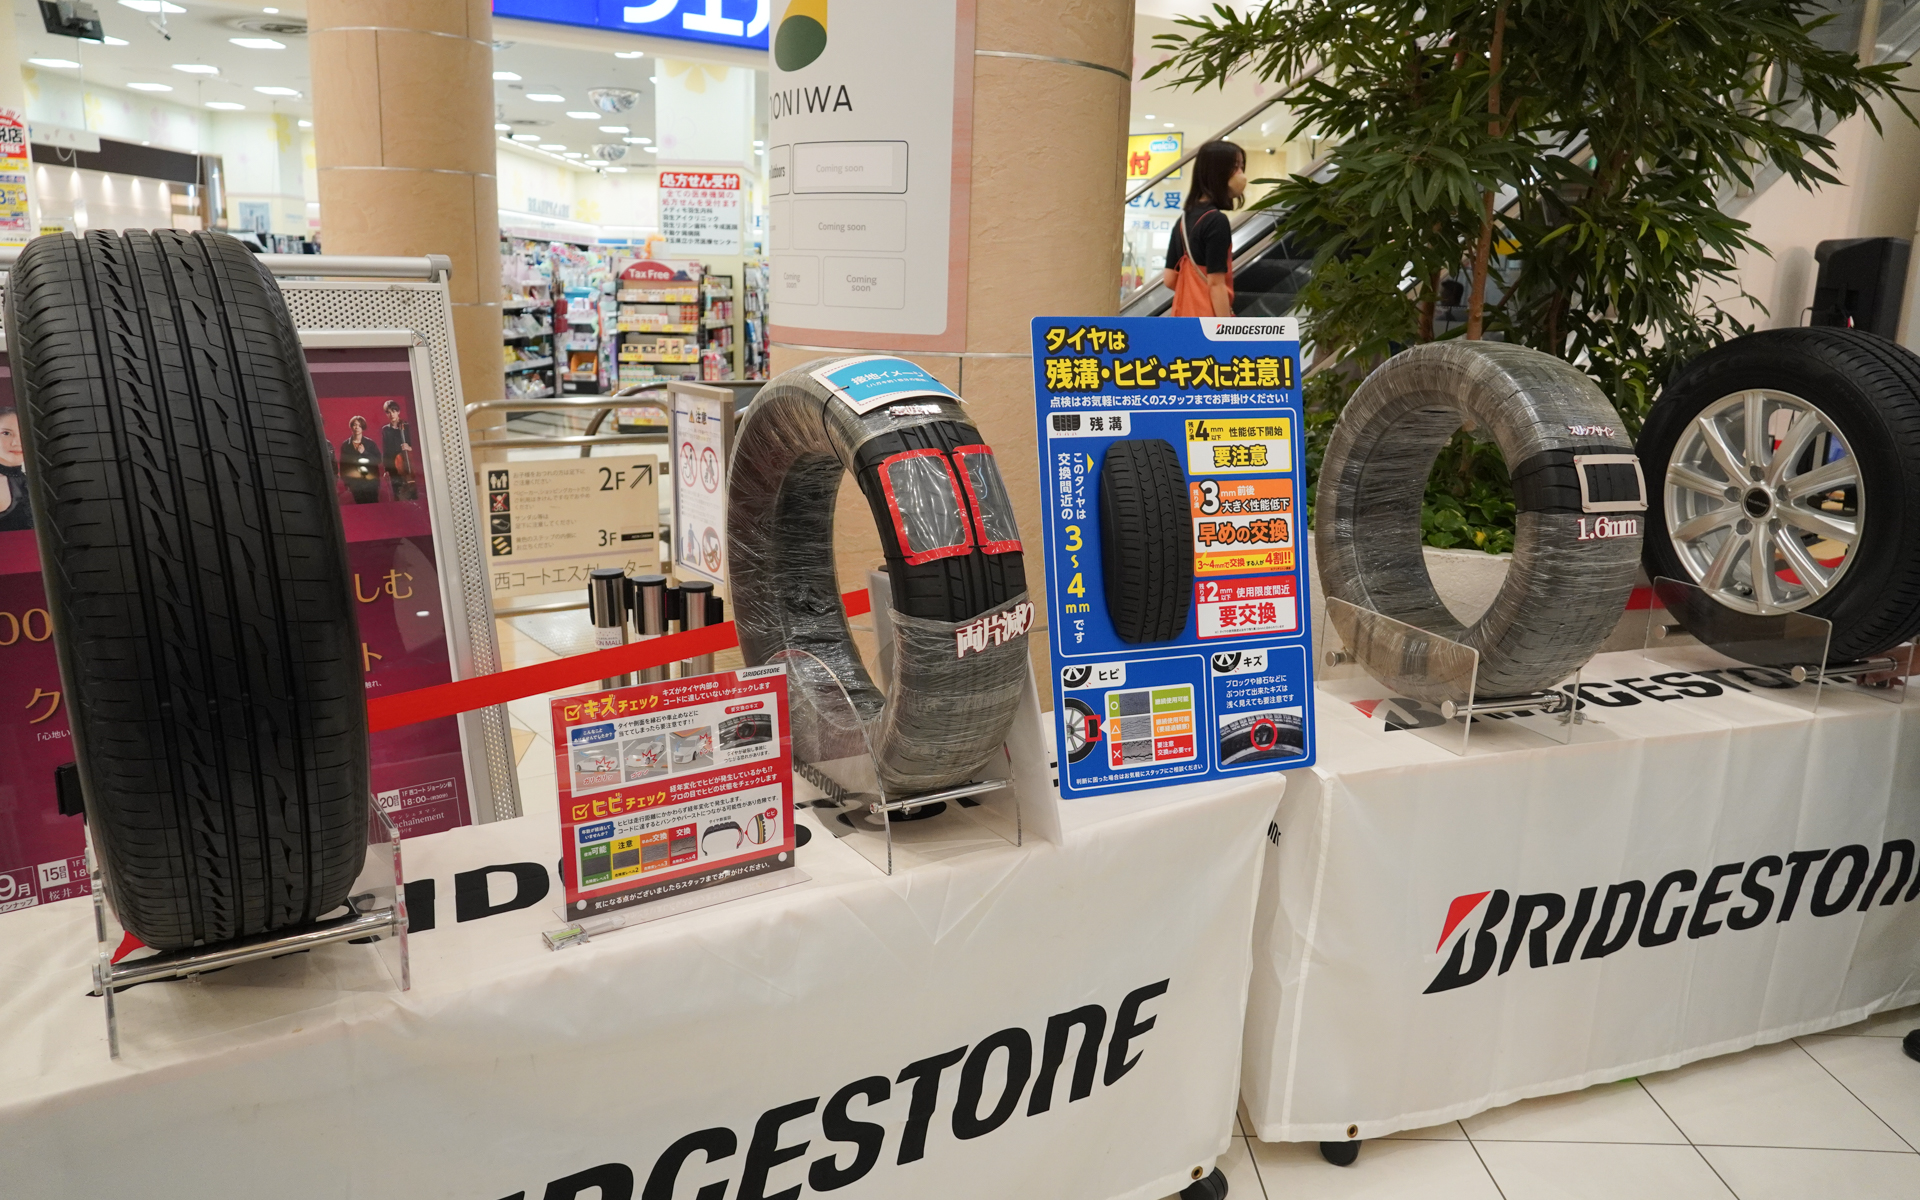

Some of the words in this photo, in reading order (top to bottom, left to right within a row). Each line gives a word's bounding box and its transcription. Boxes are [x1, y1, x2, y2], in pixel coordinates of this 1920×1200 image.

[816, 164, 843, 174] Coming
[844, 164, 864, 173] soon
[1129, 151, 1150, 175] 付
[661, 173, 738, 189] 処方せん受付
[662, 198, 738, 208] 処方せんを受付ます
[818, 222, 845, 233] Coming
[847, 222, 866, 231] soon
[628, 267, 647, 279] Tax
[648, 268, 670, 280] Free
[784, 272, 800, 283] Coming
[846, 274, 877, 286] Coming
[786, 281, 797, 289] soon
[851, 283, 871, 292] soon
[1216, 324, 1286, 335] BRIDGESTONE
[1046, 327, 1126, 351] タイヤは
[1195, 420, 1210, 441] 4
[1229, 426, 1283, 438] 性能低下開始
[1568, 425, 1615, 437] スリップサイン
[1213, 444, 1268, 468] 要注意
[513, 469, 586, 479] お子様をおつれの方は足下に
[599, 466, 626, 491] 2F
[513, 478, 552, 486] ご注意ください
[1073, 453, 1087, 520] このタイヤは
[1199, 479, 1220, 515] 3
[1237, 485, 1255, 496] 前後
[1221, 497, 1290, 514] 大きく性能低下
[515, 519, 577, 530] 足下に注意してください
[1577, 516, 1638, 540] 1.6mm
[516, 533, 577, 544] 黄色のステップの内側に
[598, 529, 617, 547] 3F
[1198, 518, 1289, 547] 早めの交換
[516, 542, 554, 551] お立ちください
[1206, 581, 1219, 602] 2
[1236, 584, 1290, 599] 使用限度間近
[1219, 602, 1277, 628] 要交換
[956, 601, 1034, 659] 両片減り
[1243, 655, 1263, 667] キズ
[742, 667, 780, 679] BRIDGESTONE
[1099, 668, 1119, 681] ヒビ
[1226, 674, 1287, 688] ブロックや縁石などに
[662, 681, 719, 697] キズがタイヤ内部の
[663, 682, 771, 706] コードに達していないかチェックします
[1226, 684, 1288, 698] ぶつけて出来たキズは
[25, 688, 60, 724] ク
[1154, 696, 1189, 705] 継続使用可能
[1226, 694, 1294, 709] 浅く見えても要注意です
[731, 703, 759, 713] 要交換のキズ
[618, 710, 699, 729] タイヤ側面を縁石や車止めなどに
[1157, 747, 1192, 756] 交換が必要です
[1076, 764, 1203, 785] 判断に困った場合はお気軽にスタッフにご相談ください
[670, 773, 778, 801] プロの目でヒビの状態をチェックします
[676, 827, 691, 837] 交換
[618, 840, 633, 850] 注意
[43, 867, 59, 882] 15
